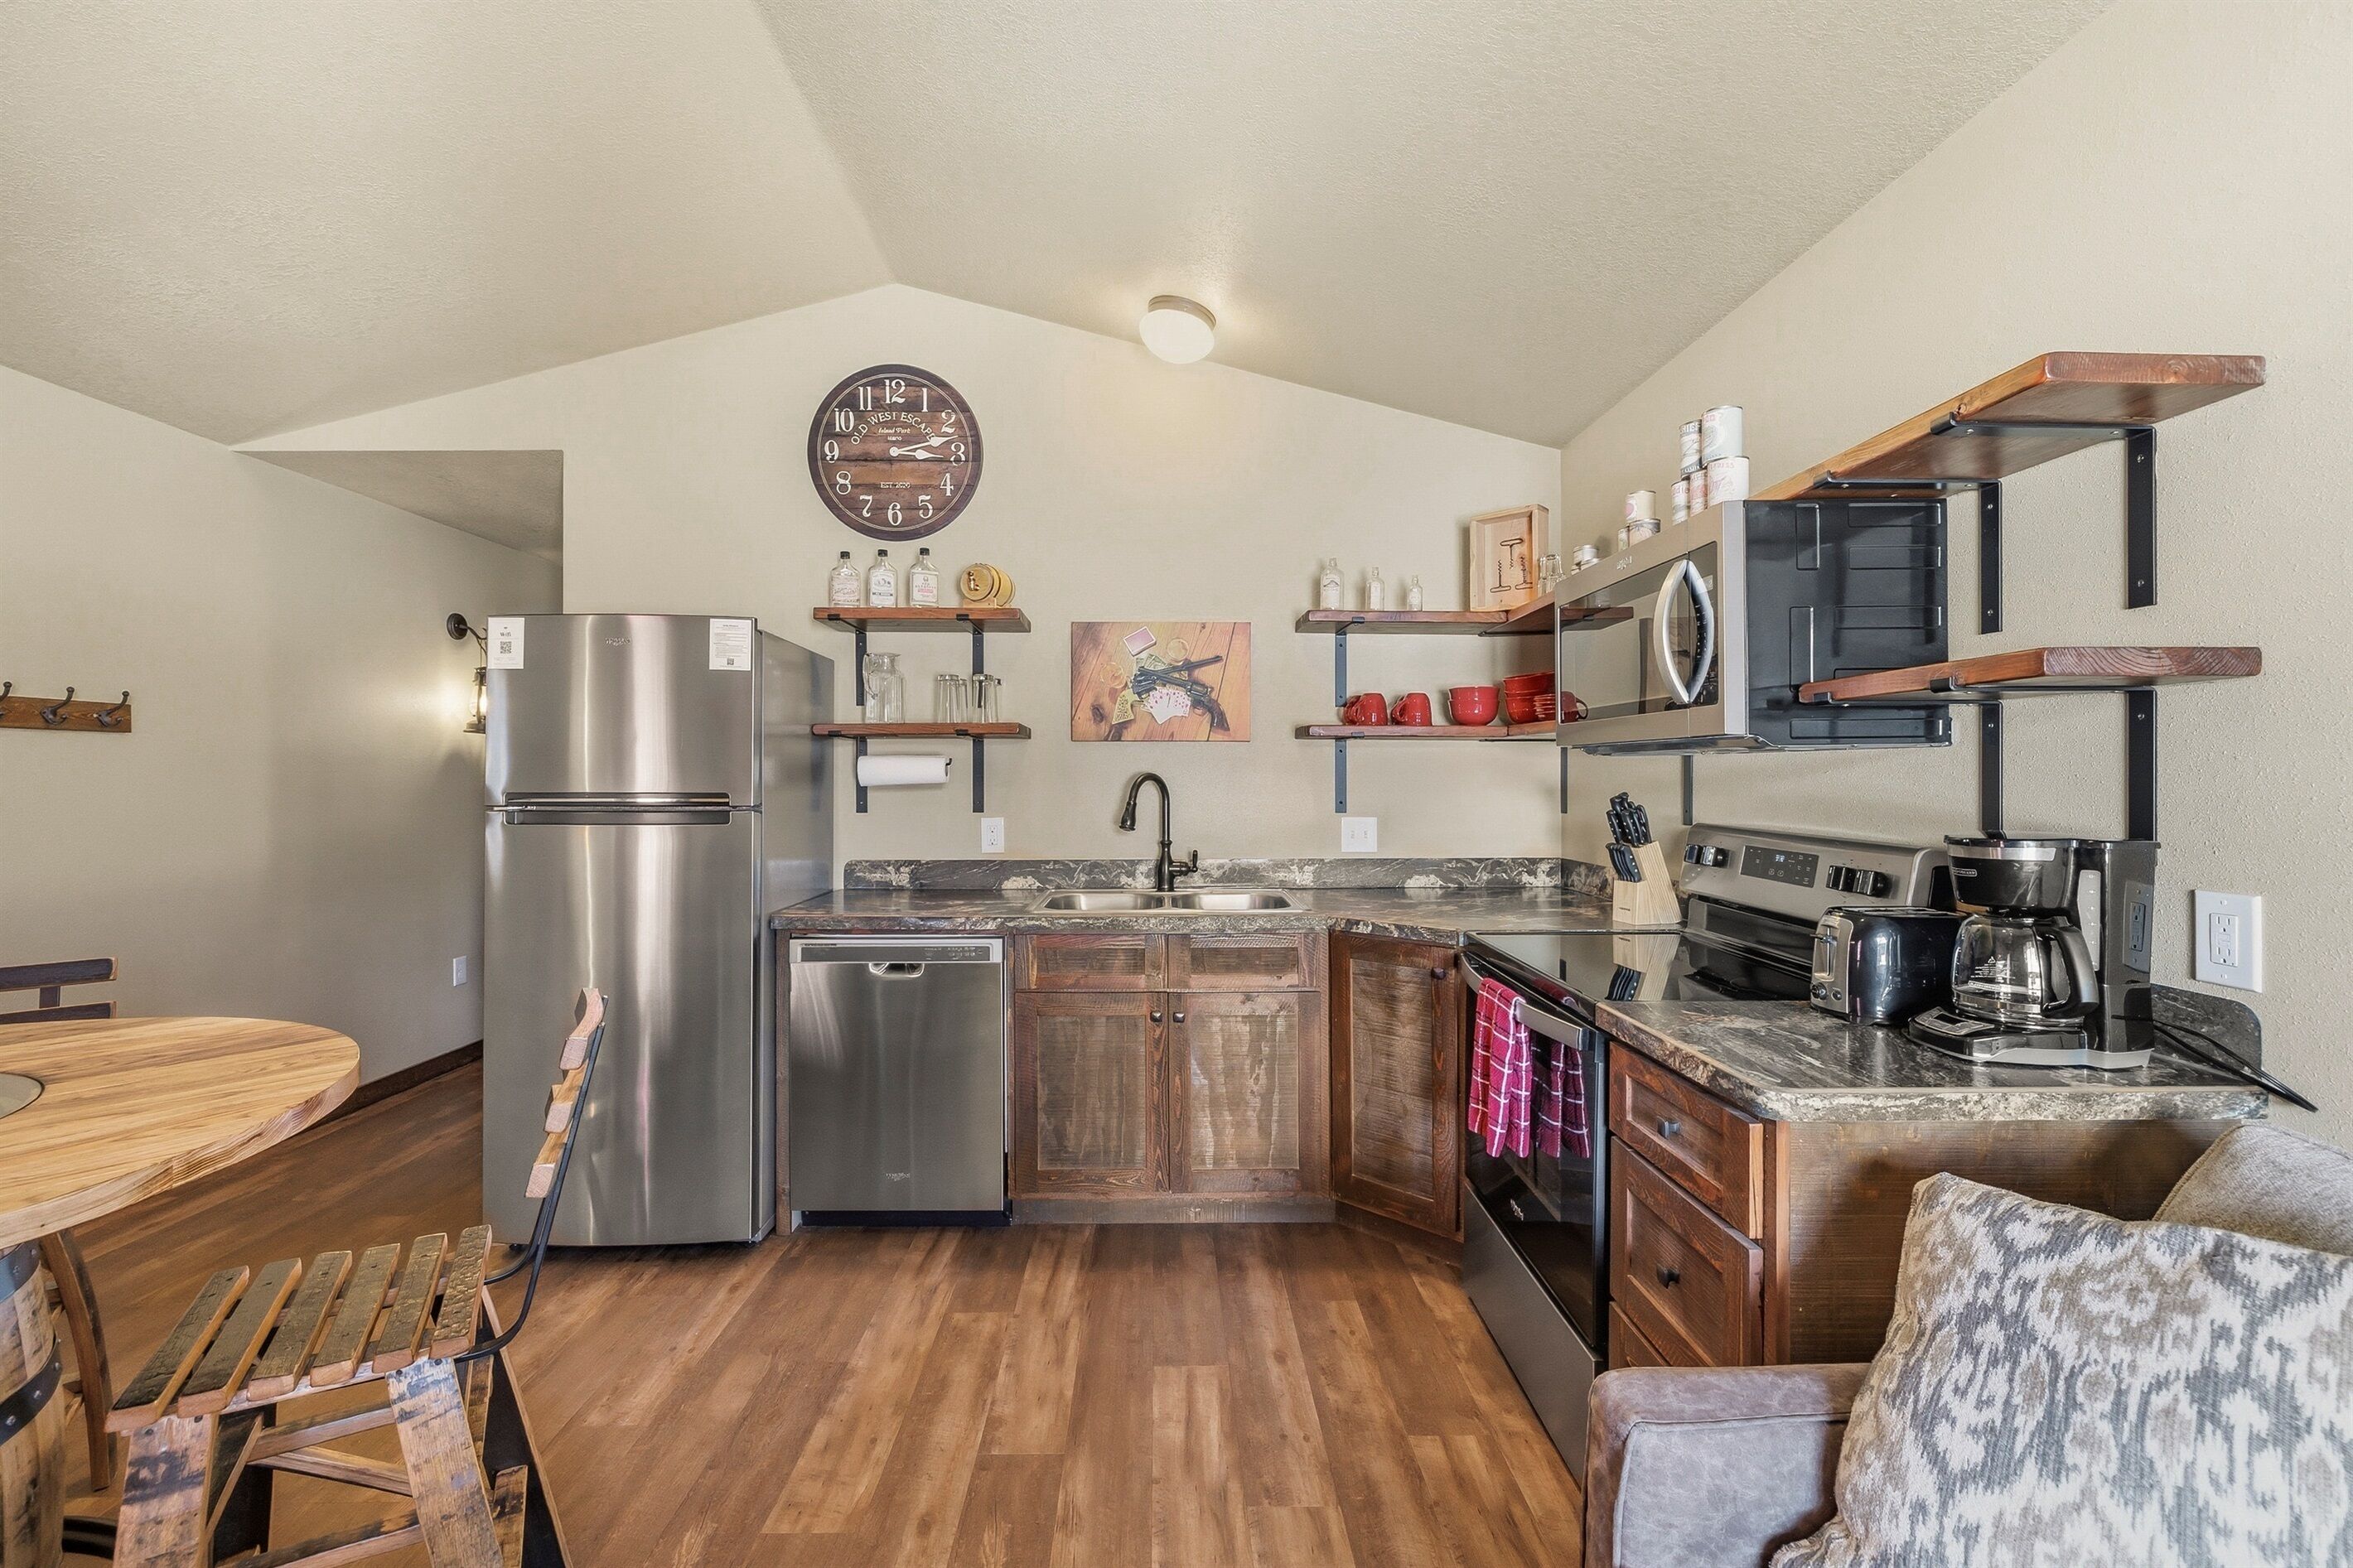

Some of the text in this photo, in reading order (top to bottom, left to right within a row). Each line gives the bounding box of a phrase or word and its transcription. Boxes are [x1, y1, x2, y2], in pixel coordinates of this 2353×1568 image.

[858, 386, 873, 411] 11
[884, 379, 906, 404] 12
[921, 388, 929, 413] 1
[834, 408, 855, 432] 10
[851, 412, 936, 445] OLD WEST ESCAPE
[940, 409, 956, 433] 2
[824, 440, 839, 464] 9
[950, 441, 966, 466] 3
[836, 470, 852, 495] 8
[940, 472, 954, 497] 4
[859, 495, 873, 518] 7
[887, 502, 903, 526] 6
[918, 495, 934, 519] 5
